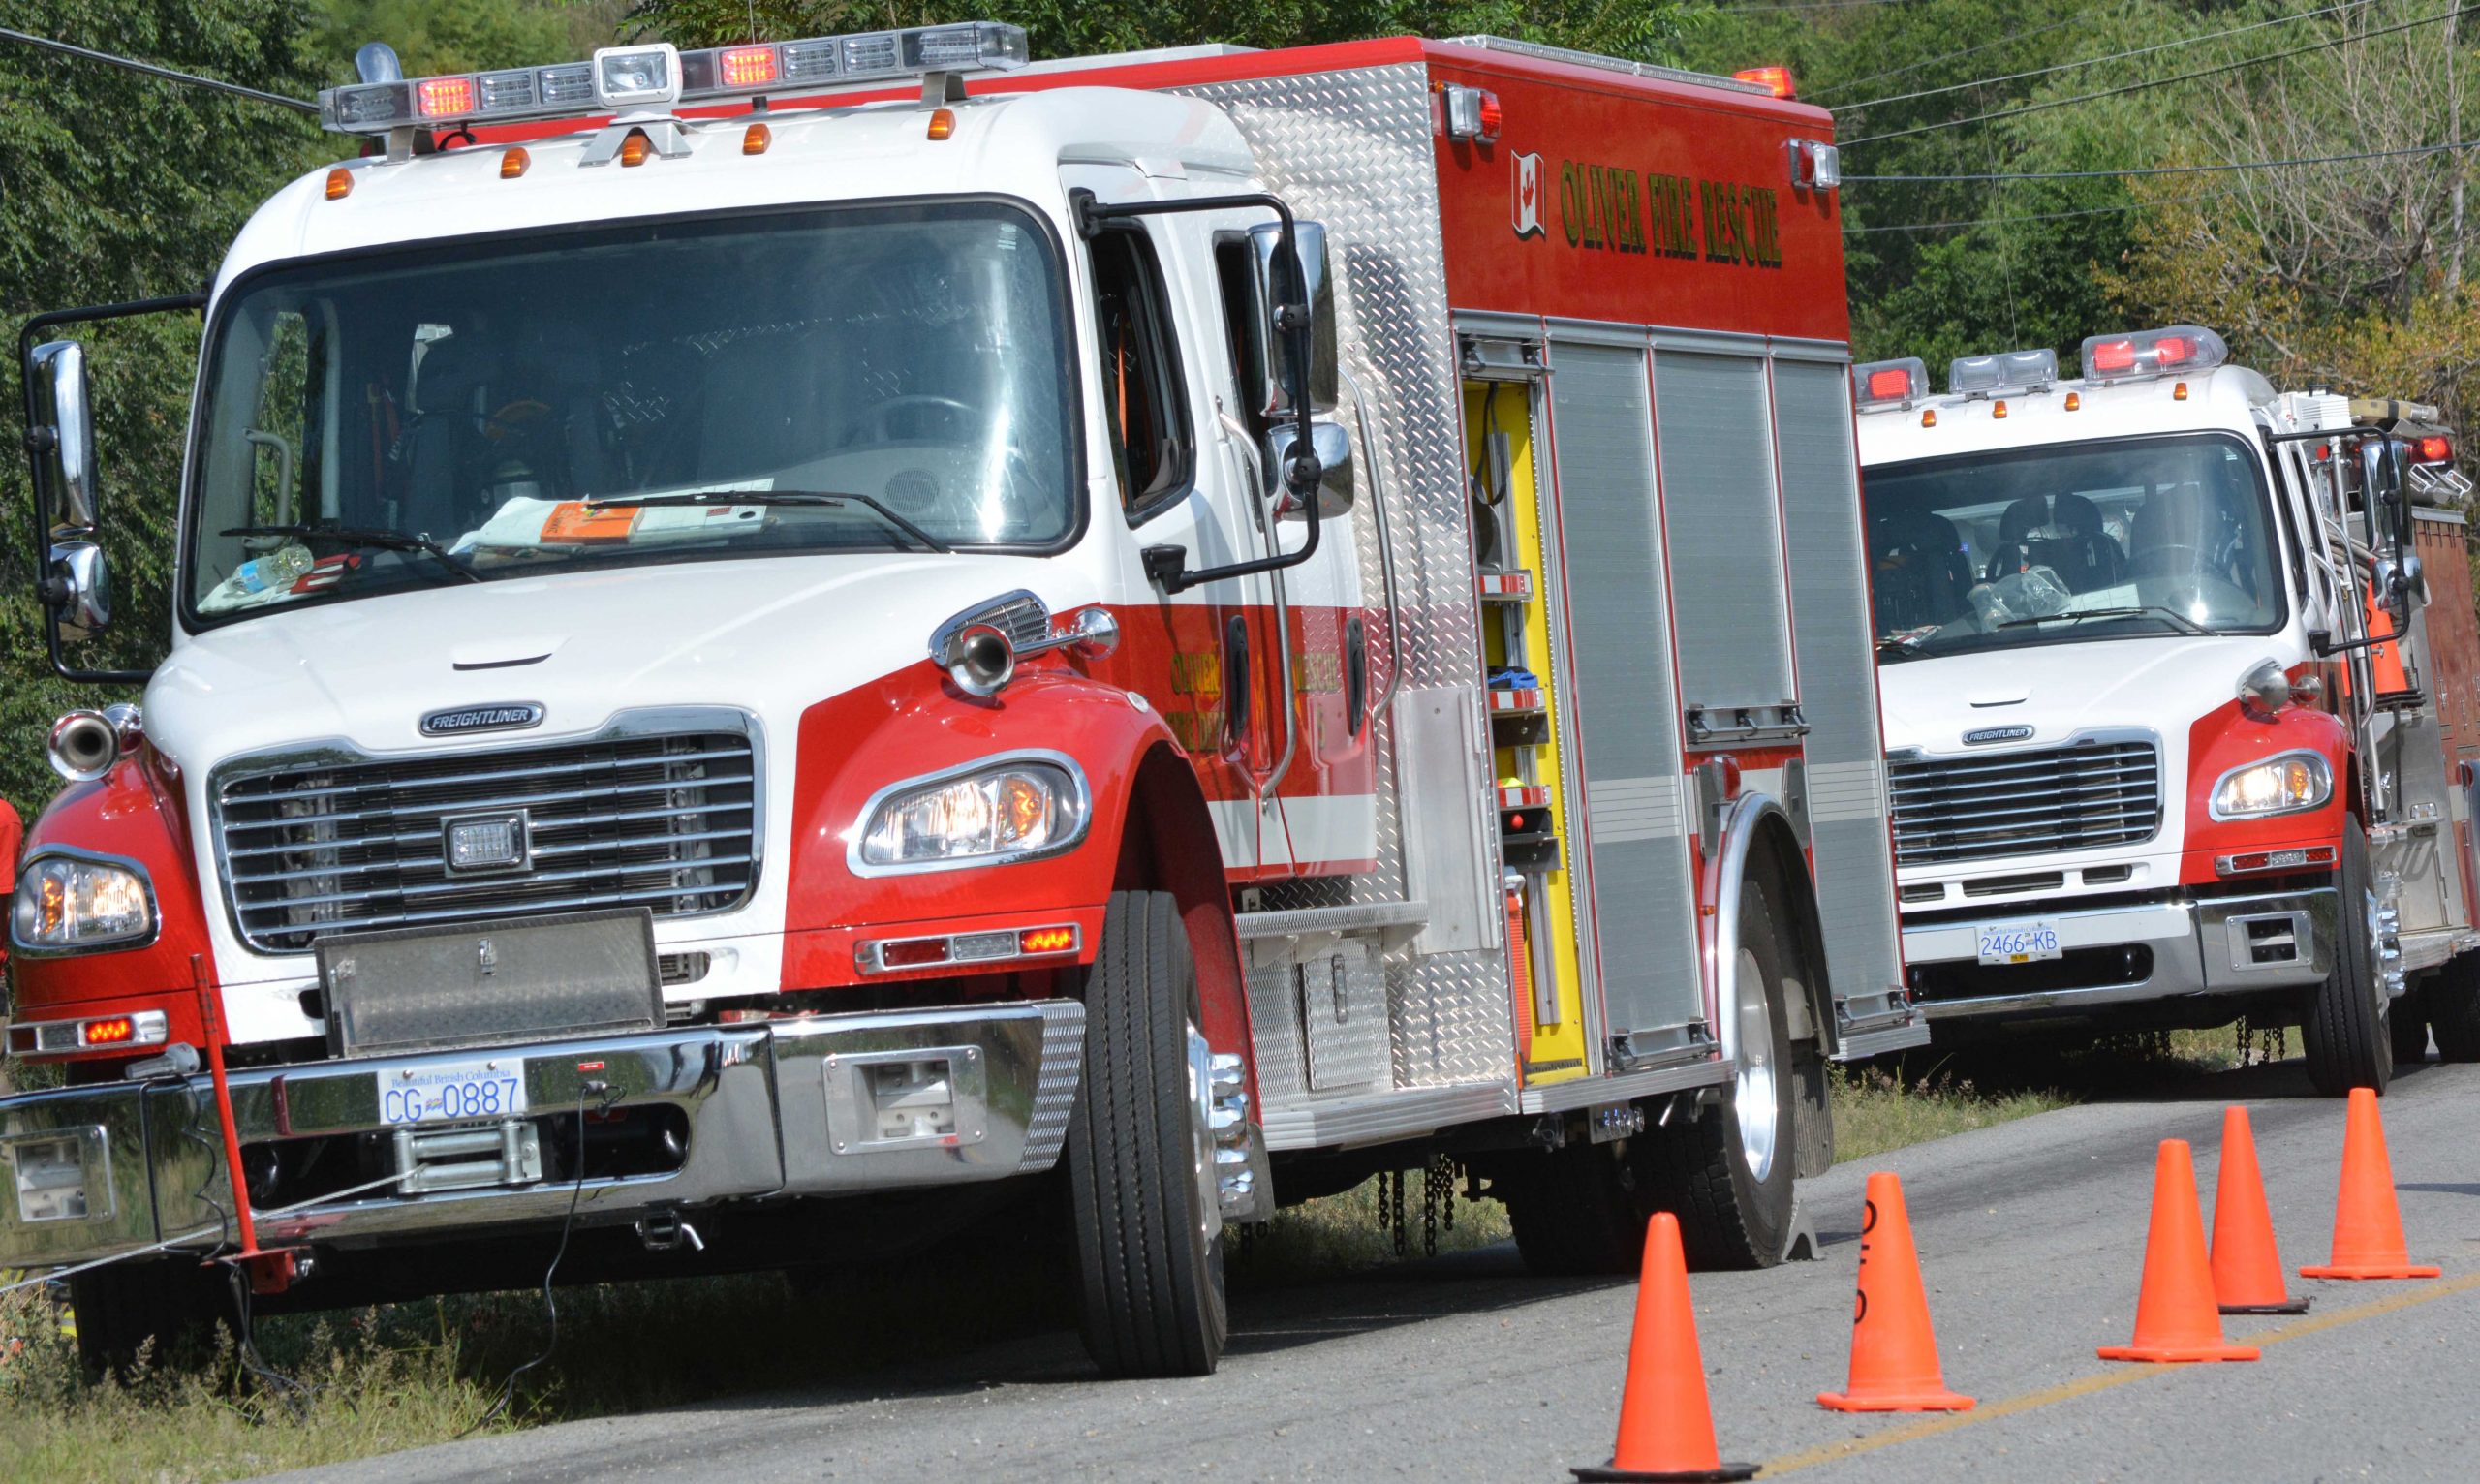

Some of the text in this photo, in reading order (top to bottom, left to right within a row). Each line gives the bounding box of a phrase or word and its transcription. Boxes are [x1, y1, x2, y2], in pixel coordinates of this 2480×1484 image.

[1561, 159, 1782, 268] OLIVER FIRE RESCUE
[1170, 651, 1220, 694] OLIVER
[431, 709, 529, 728] FREIGHTLINER
[1969, 728, 2026, 741] FREIGHTLINER
[1981, 931, 2057, 955] 2466 KB
[435, 1072, 464, 1084] British
[466, 1069, 510, 1081] Columbia
[386, 1078, 518, 1123] CG 0887
